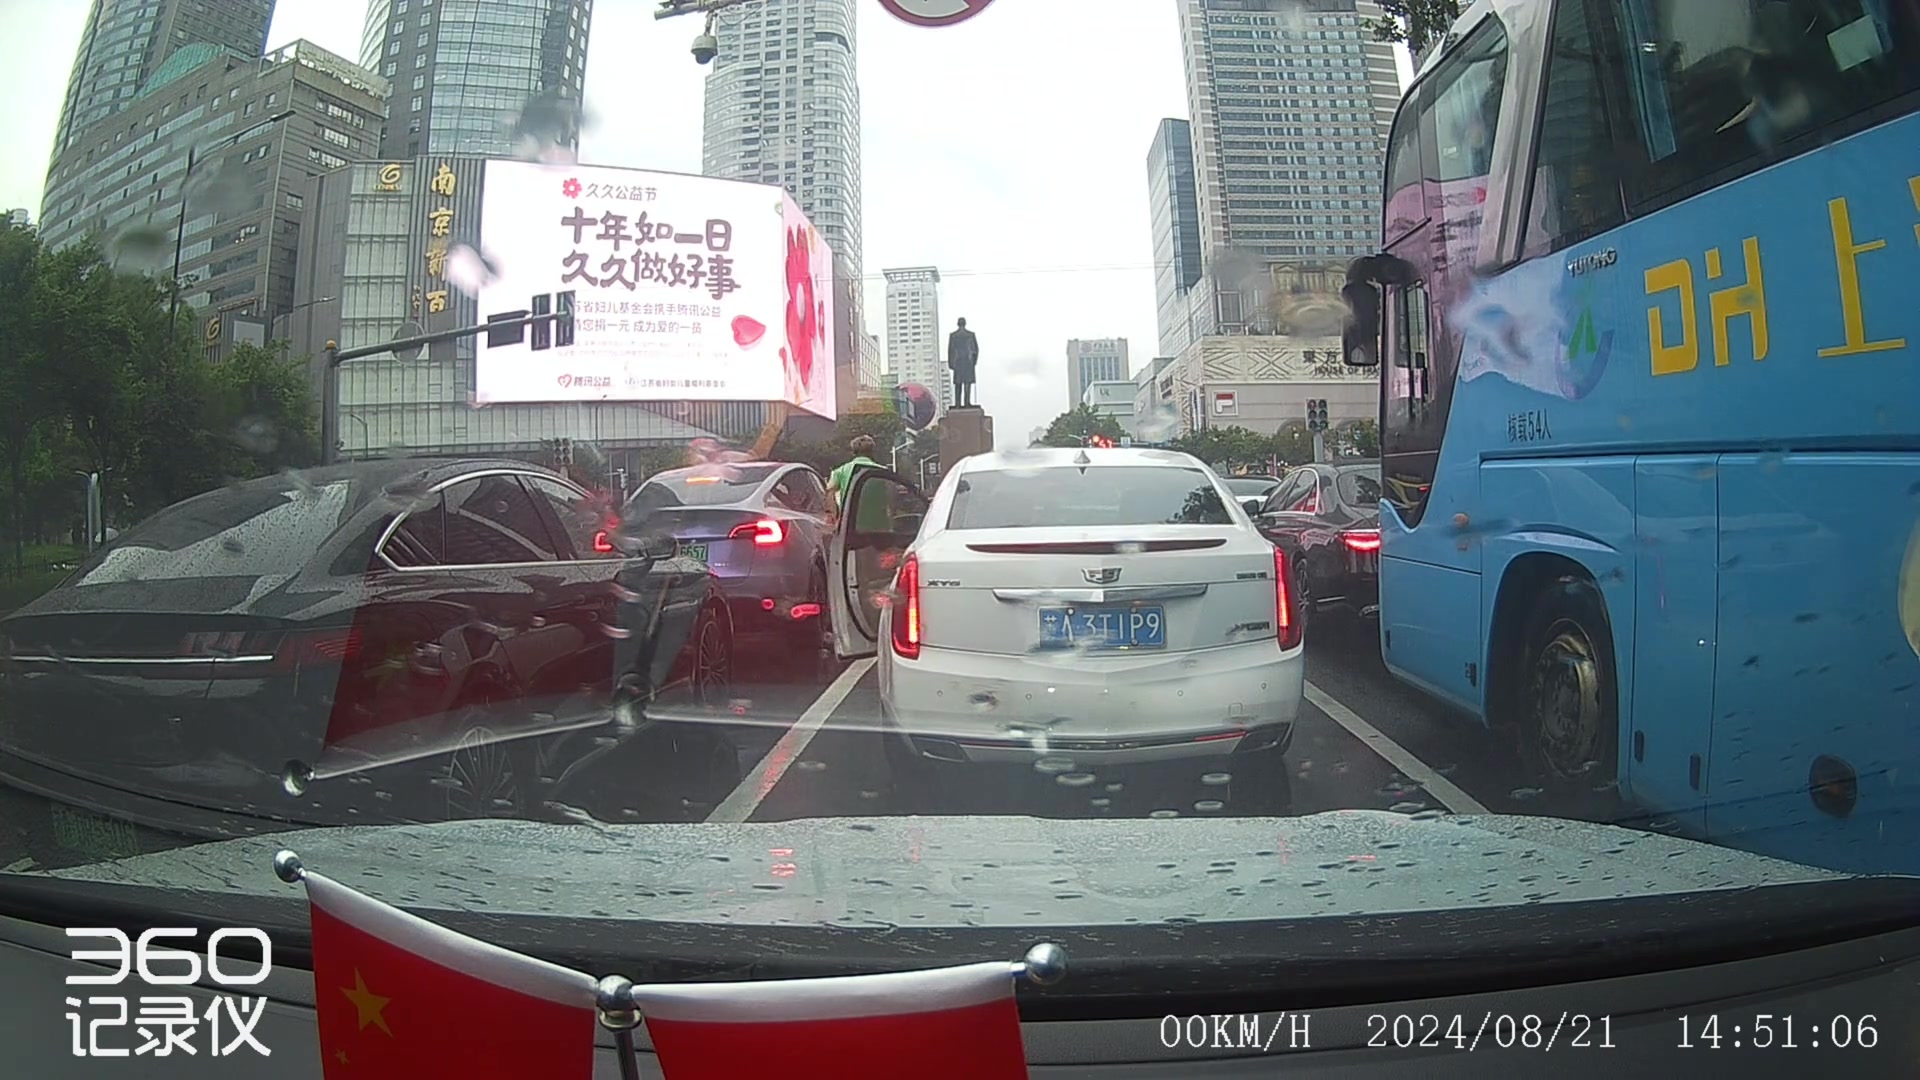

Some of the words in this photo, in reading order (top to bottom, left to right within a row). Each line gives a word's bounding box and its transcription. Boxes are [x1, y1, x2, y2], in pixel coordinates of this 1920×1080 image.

[585, 182, 658, 201] 久久公益节
[560, 205, 733, 252] 十年如一日
[561, 248, 741, 300] 久久做好事
[1567, 248, 1617, 277] YUTONG
